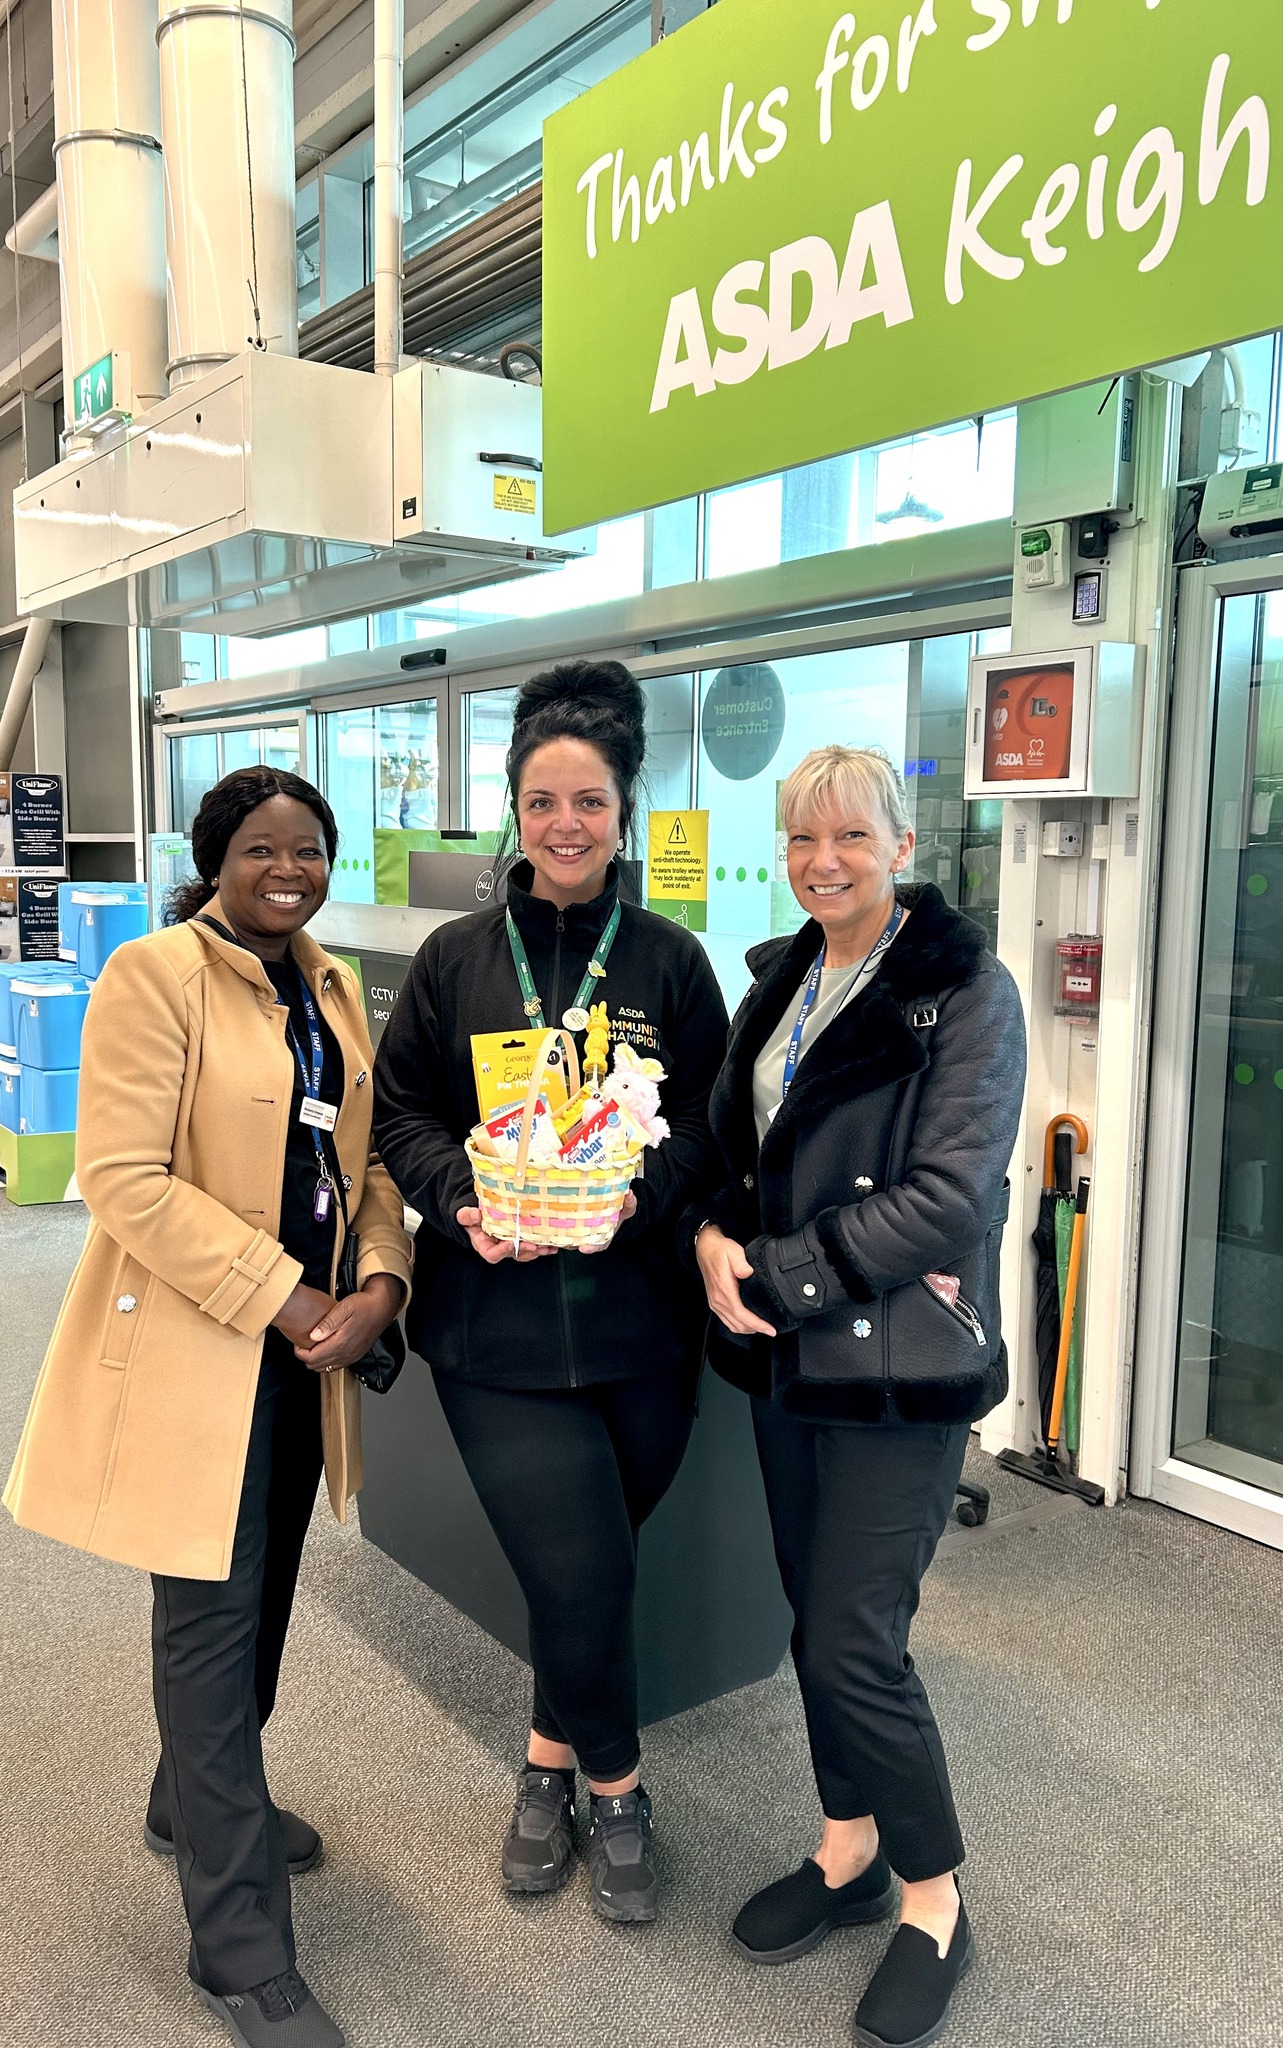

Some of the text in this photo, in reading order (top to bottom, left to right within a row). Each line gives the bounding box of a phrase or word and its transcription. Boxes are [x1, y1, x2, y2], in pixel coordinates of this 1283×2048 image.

[576, 0, 938, 259] Thanks for
[649, 53, 1269, 413] ASDA Keigh
[995, 752, 1023, 766] ASDA
[672, 849, 691, 857] operate
[672, 867, 687, 875] trolley
[674, 875, 695, 883] suddenly
[809, 968, 820, 991] STAFF
[371, 986, 394, 1002] CCTV
[305, 1001, 316, 1020] STAFF
[618, 1006, 645, 1018] ASDA
[312, 1031, 321, 1052] STAFF
[608, 1031, 660, 1051] HAMPION
[788, 1040, 798, 1065] STAFF
[313, 1067, 321, 1091] STAFF
